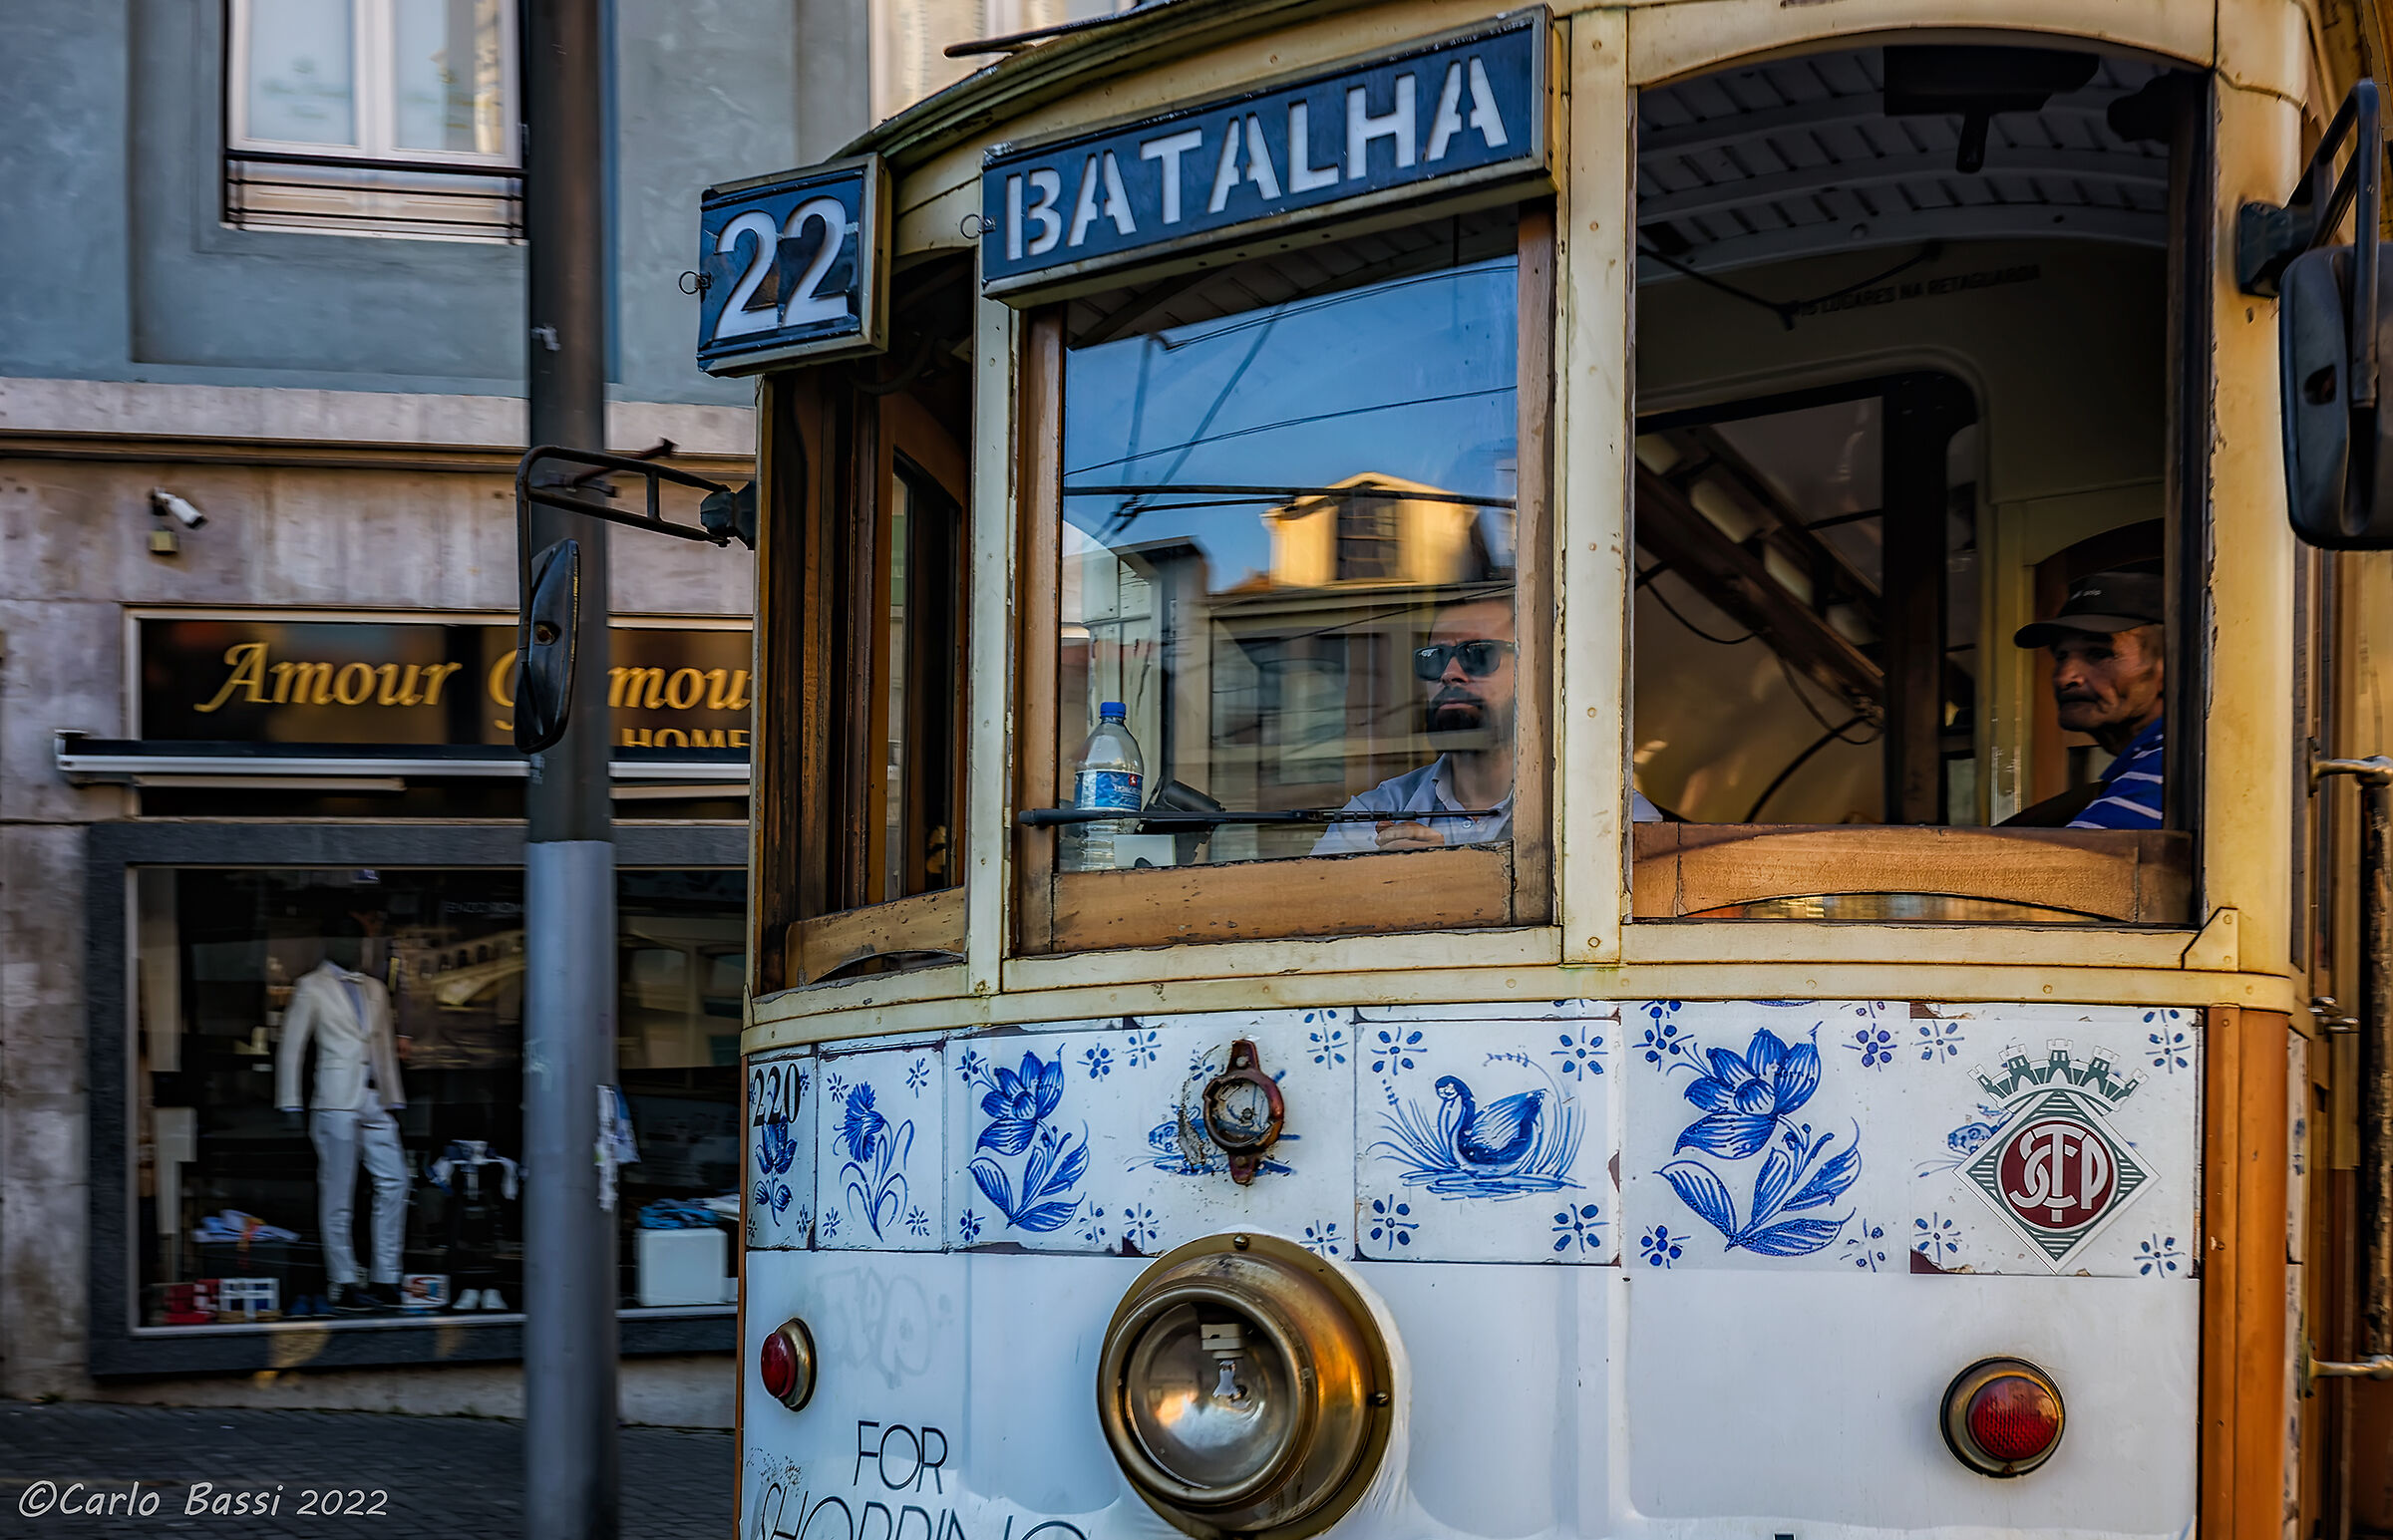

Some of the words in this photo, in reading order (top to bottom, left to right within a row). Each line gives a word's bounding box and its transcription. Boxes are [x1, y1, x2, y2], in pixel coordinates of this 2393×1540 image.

[1005, 56, 1509, 262] BATALHA
[715, 195, 849, 340] 22
[194, 641, 463, 713] Amour
[753, 1063, 801, 1127] 220
[854, 1419, 948, 1494] FOR
